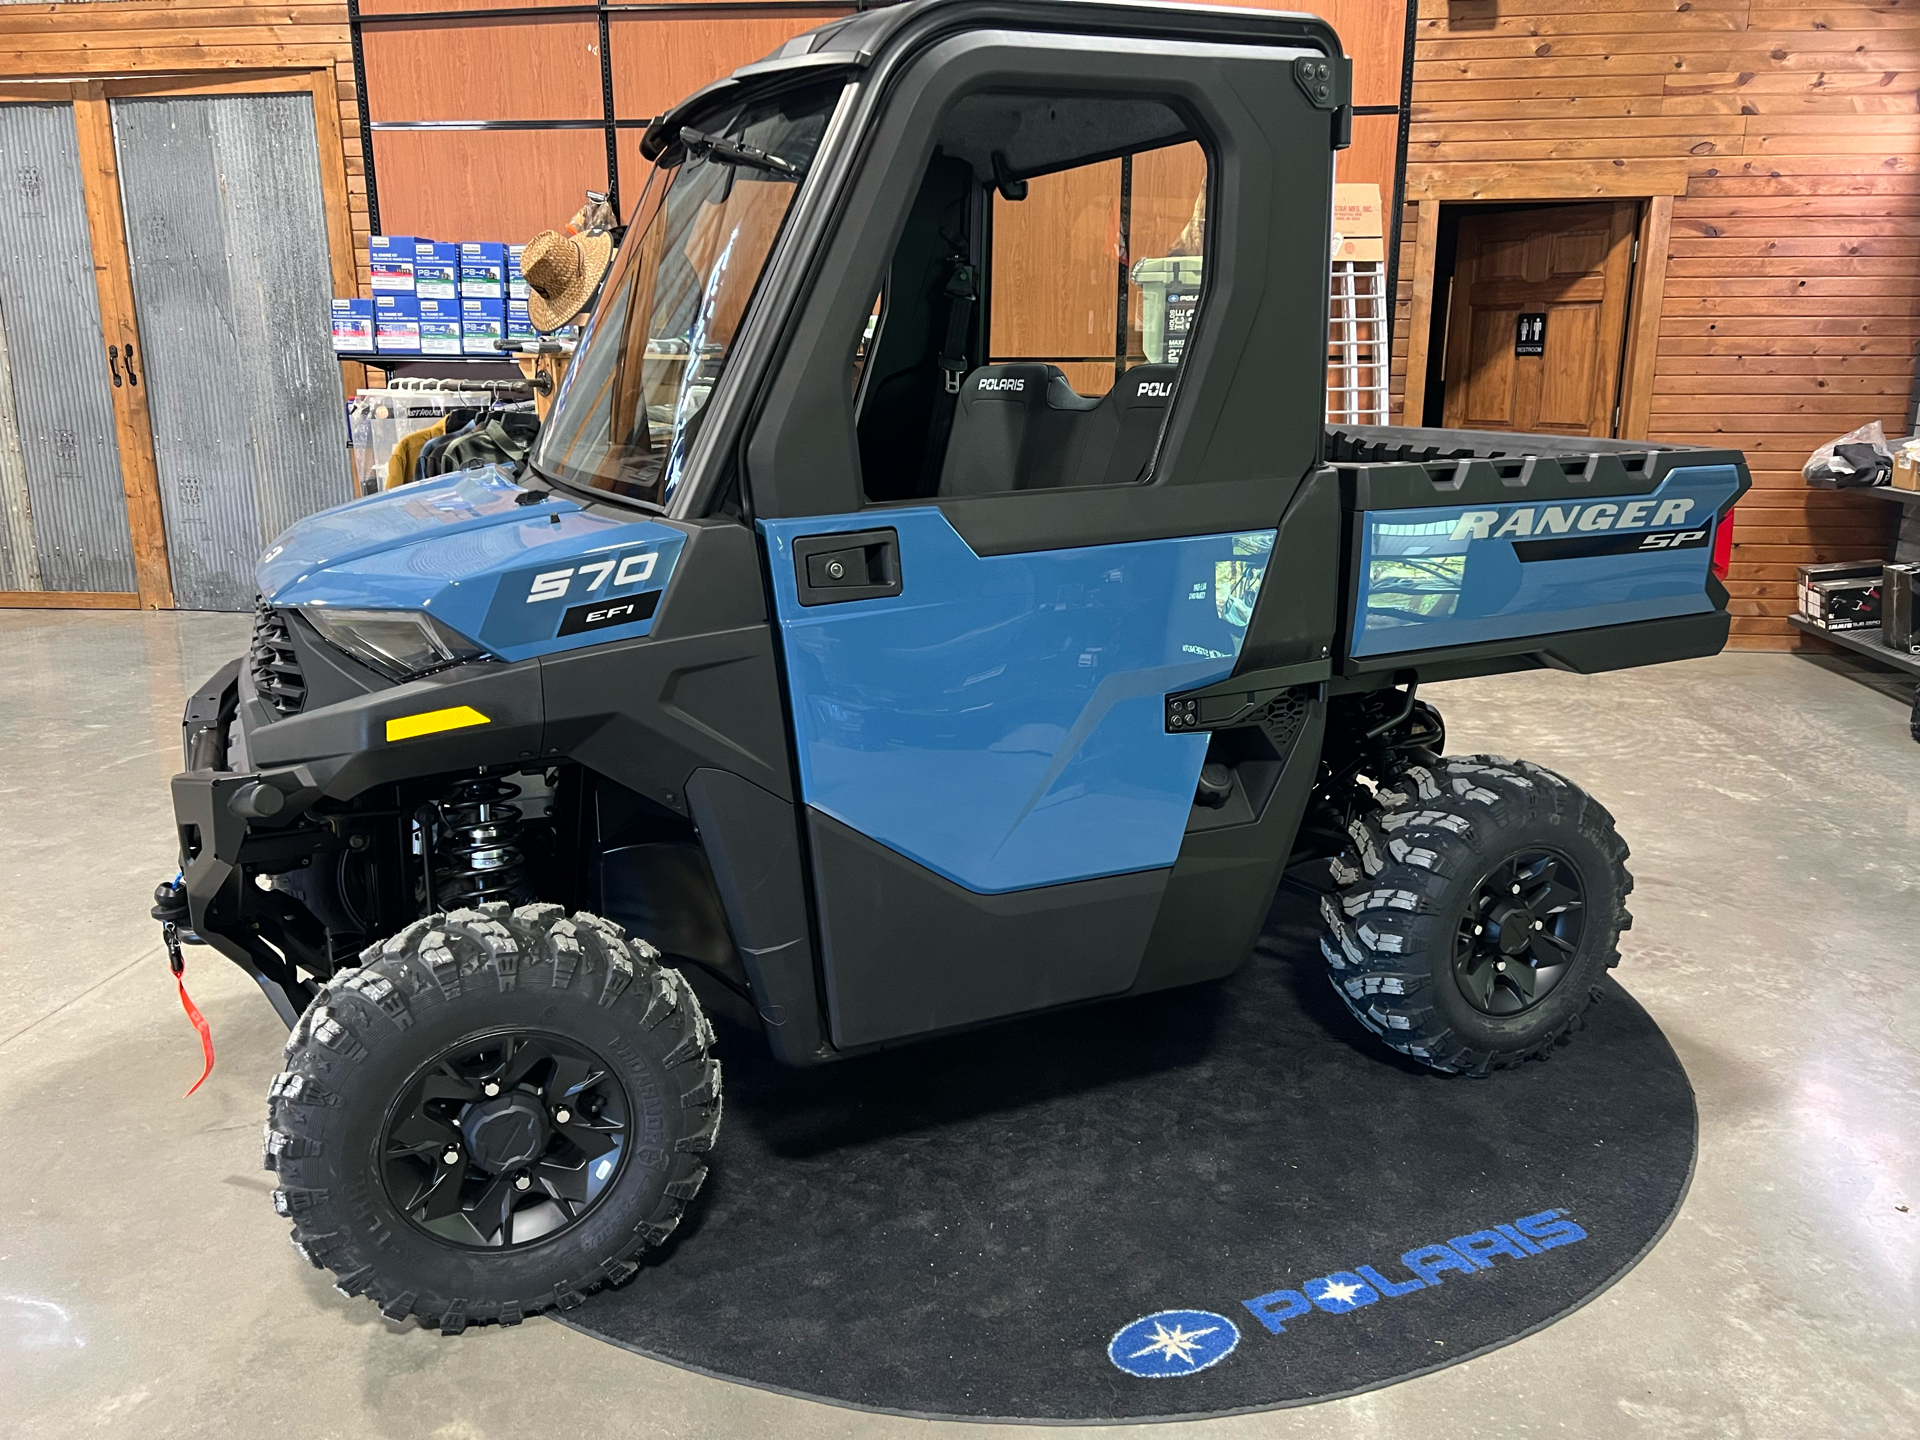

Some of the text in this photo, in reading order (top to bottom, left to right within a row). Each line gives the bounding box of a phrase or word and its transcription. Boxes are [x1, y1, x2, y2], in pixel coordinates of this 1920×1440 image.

[1175, 309, 1185, 330] ICE
[978, 378, 1024, 391] POLARIS
[408, 408, 442, 416] STHOUSE
[1449, 498, 1694, 541] RANGER
[1638, 531, 1706, 549] SP
[526, 552, 658, 603] 570
[586, 604, 634, 623] EFI
[1242, 1208, 1587, 1335] POLARIS
